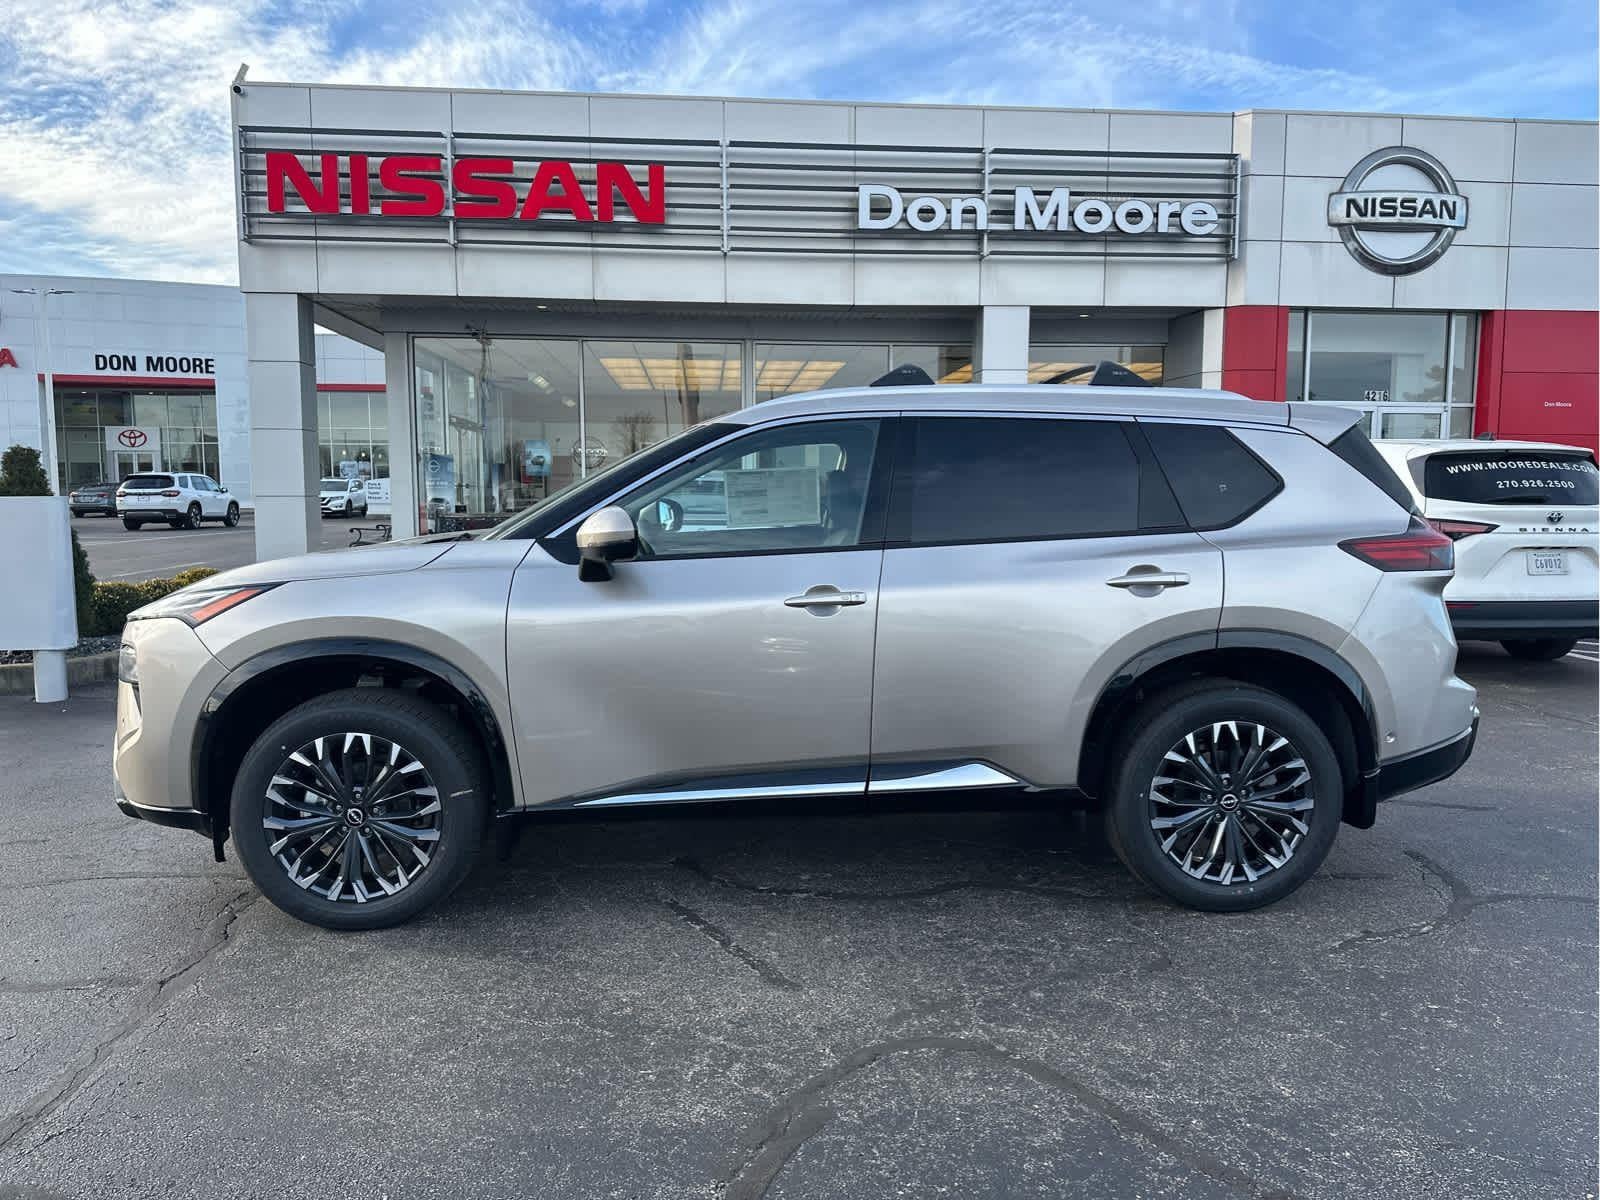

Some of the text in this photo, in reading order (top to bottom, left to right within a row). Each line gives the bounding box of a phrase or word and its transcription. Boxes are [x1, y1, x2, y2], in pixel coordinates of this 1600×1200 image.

[265, 151, 666, 225] NISSAN
[857, 183, 1219, 235] Don Moore
[1345, 197, 1457, 220] NISSAN
[94, 354, 215, 374] DON MOORE
[1496, 480, 1575, 489] 270.926.2500
